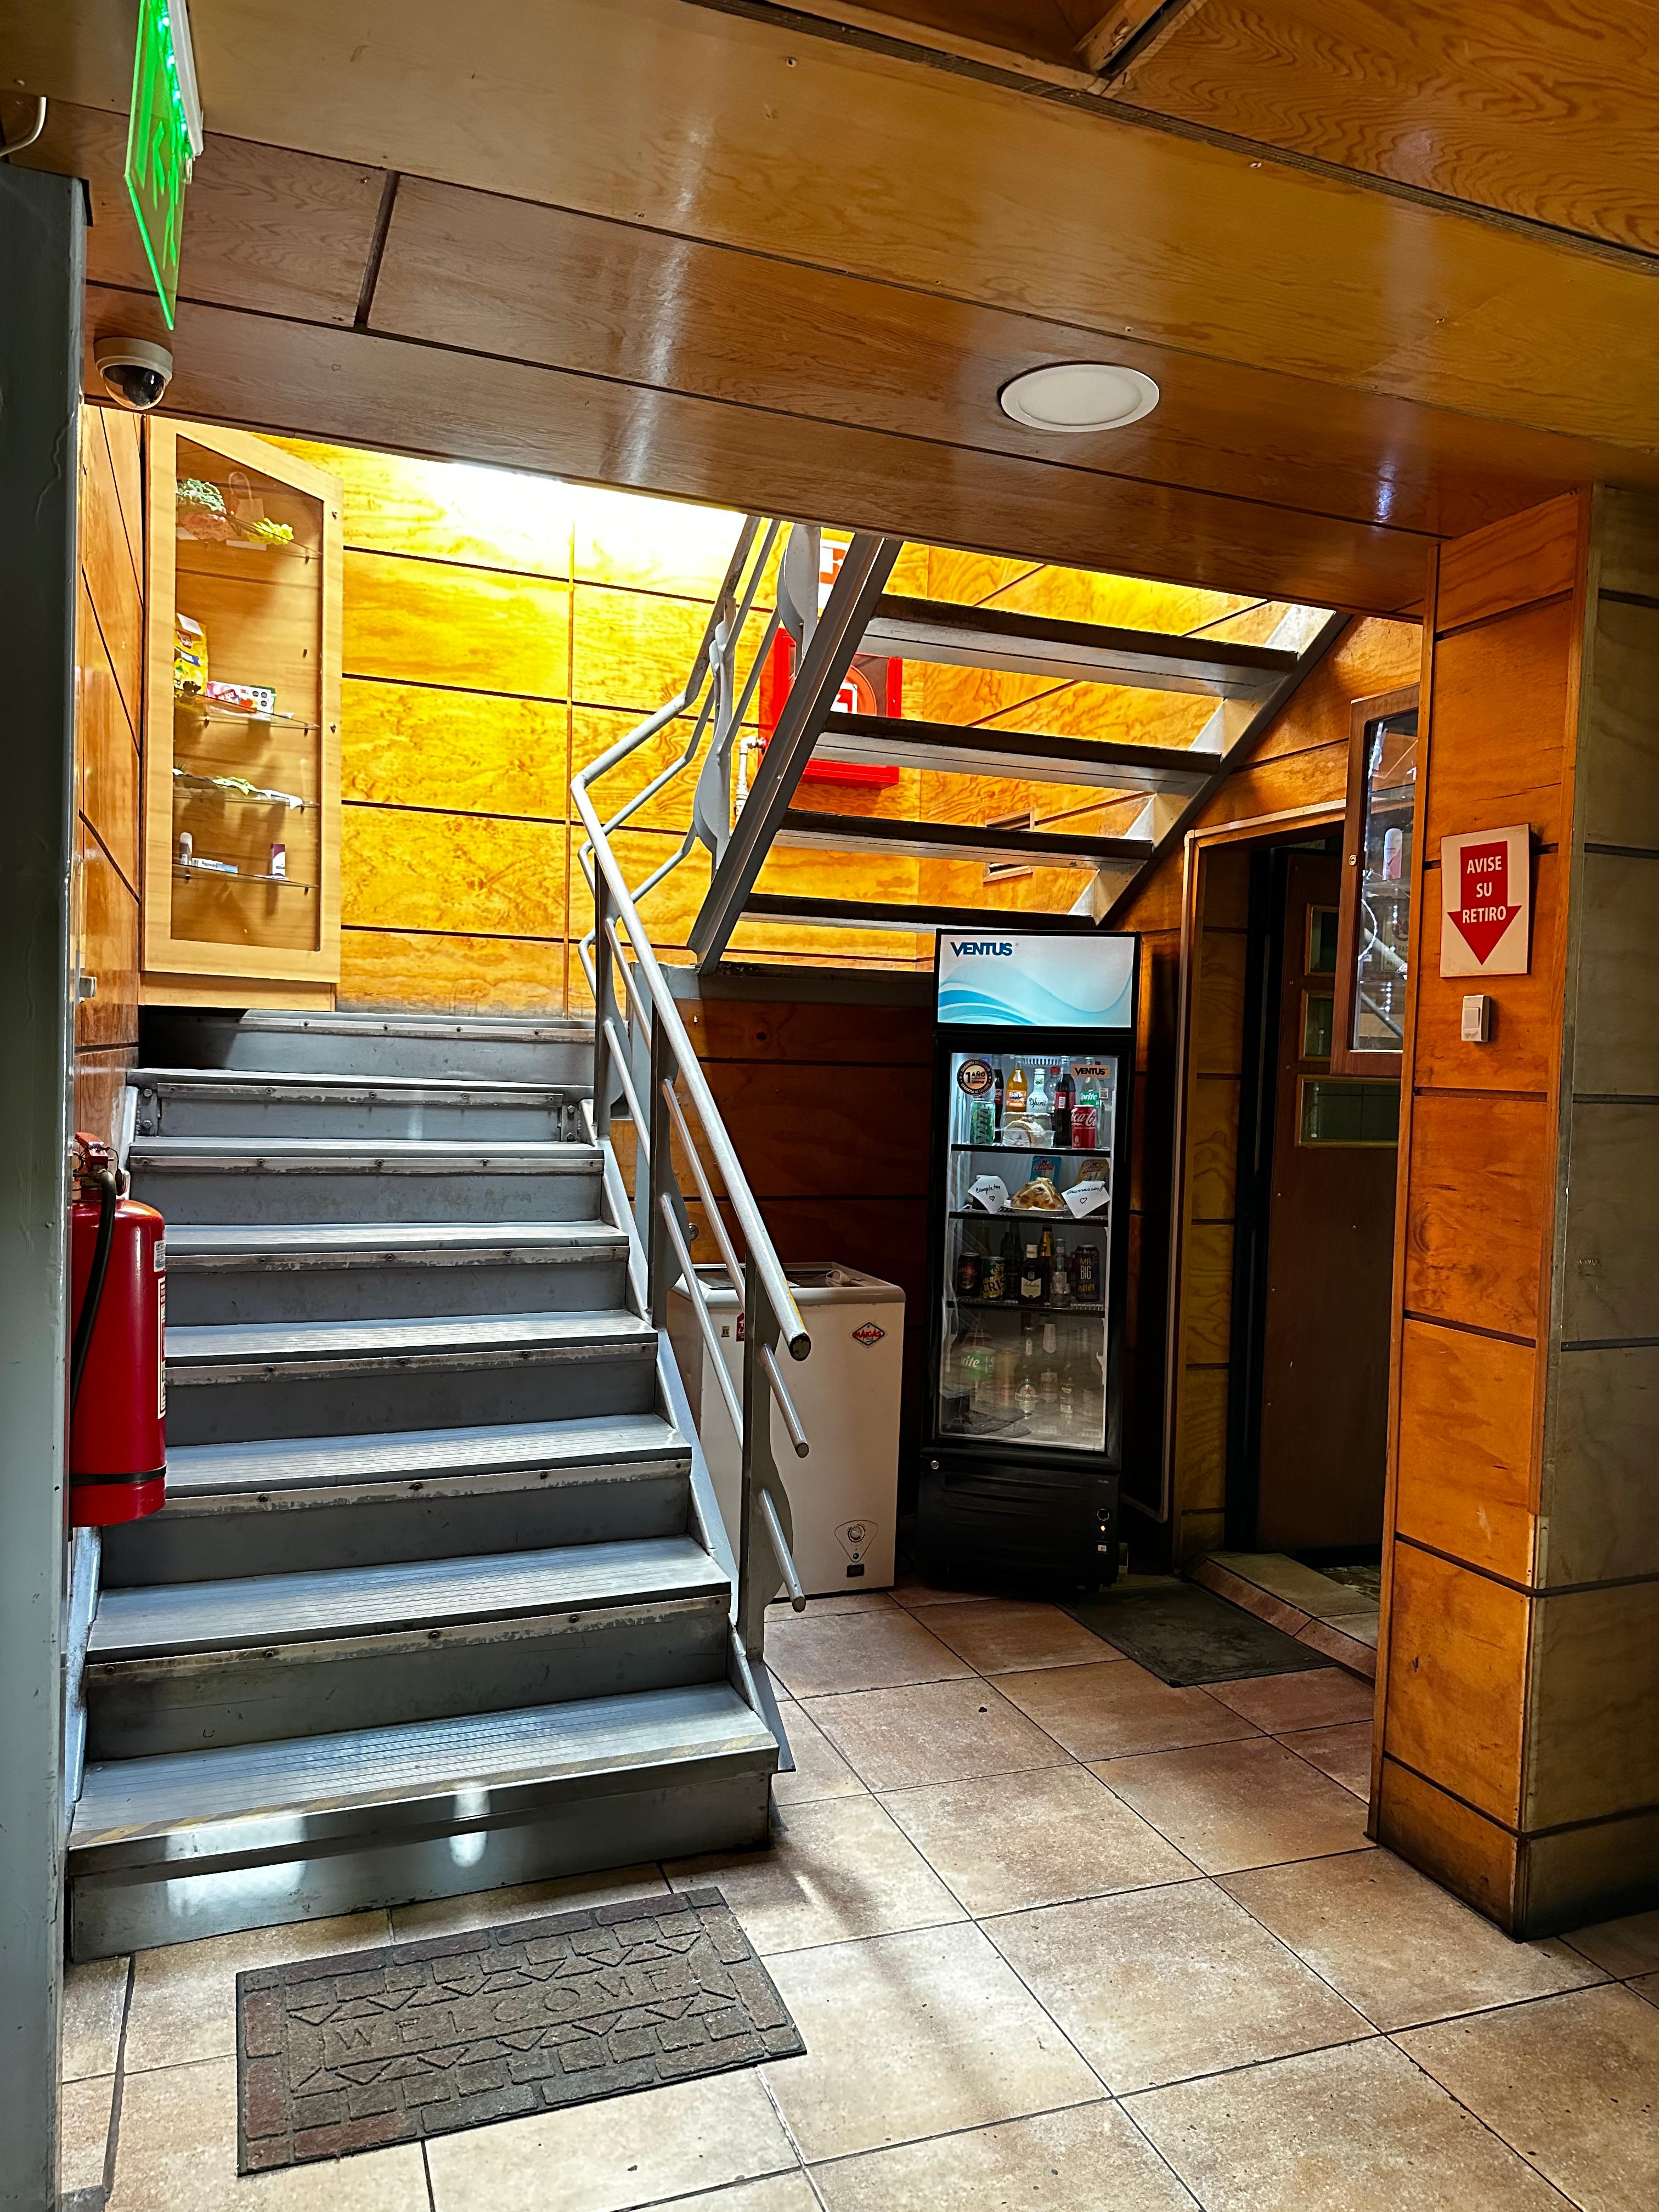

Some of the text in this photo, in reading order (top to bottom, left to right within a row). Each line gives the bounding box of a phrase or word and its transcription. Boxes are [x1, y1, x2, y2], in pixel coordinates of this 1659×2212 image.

[1466, 856, 1502, 874] AVISE
[1476, 882, 1492, 898] SU
[1462, 905, 1506, 923] RETIRO
[950, 941, 1013, 957] VENTUS
[966, 1071, 970, 1084] 1
[1080, 1265, 1091, 1279] BIG
[335, 1968, 684, 2050] WELCOME
